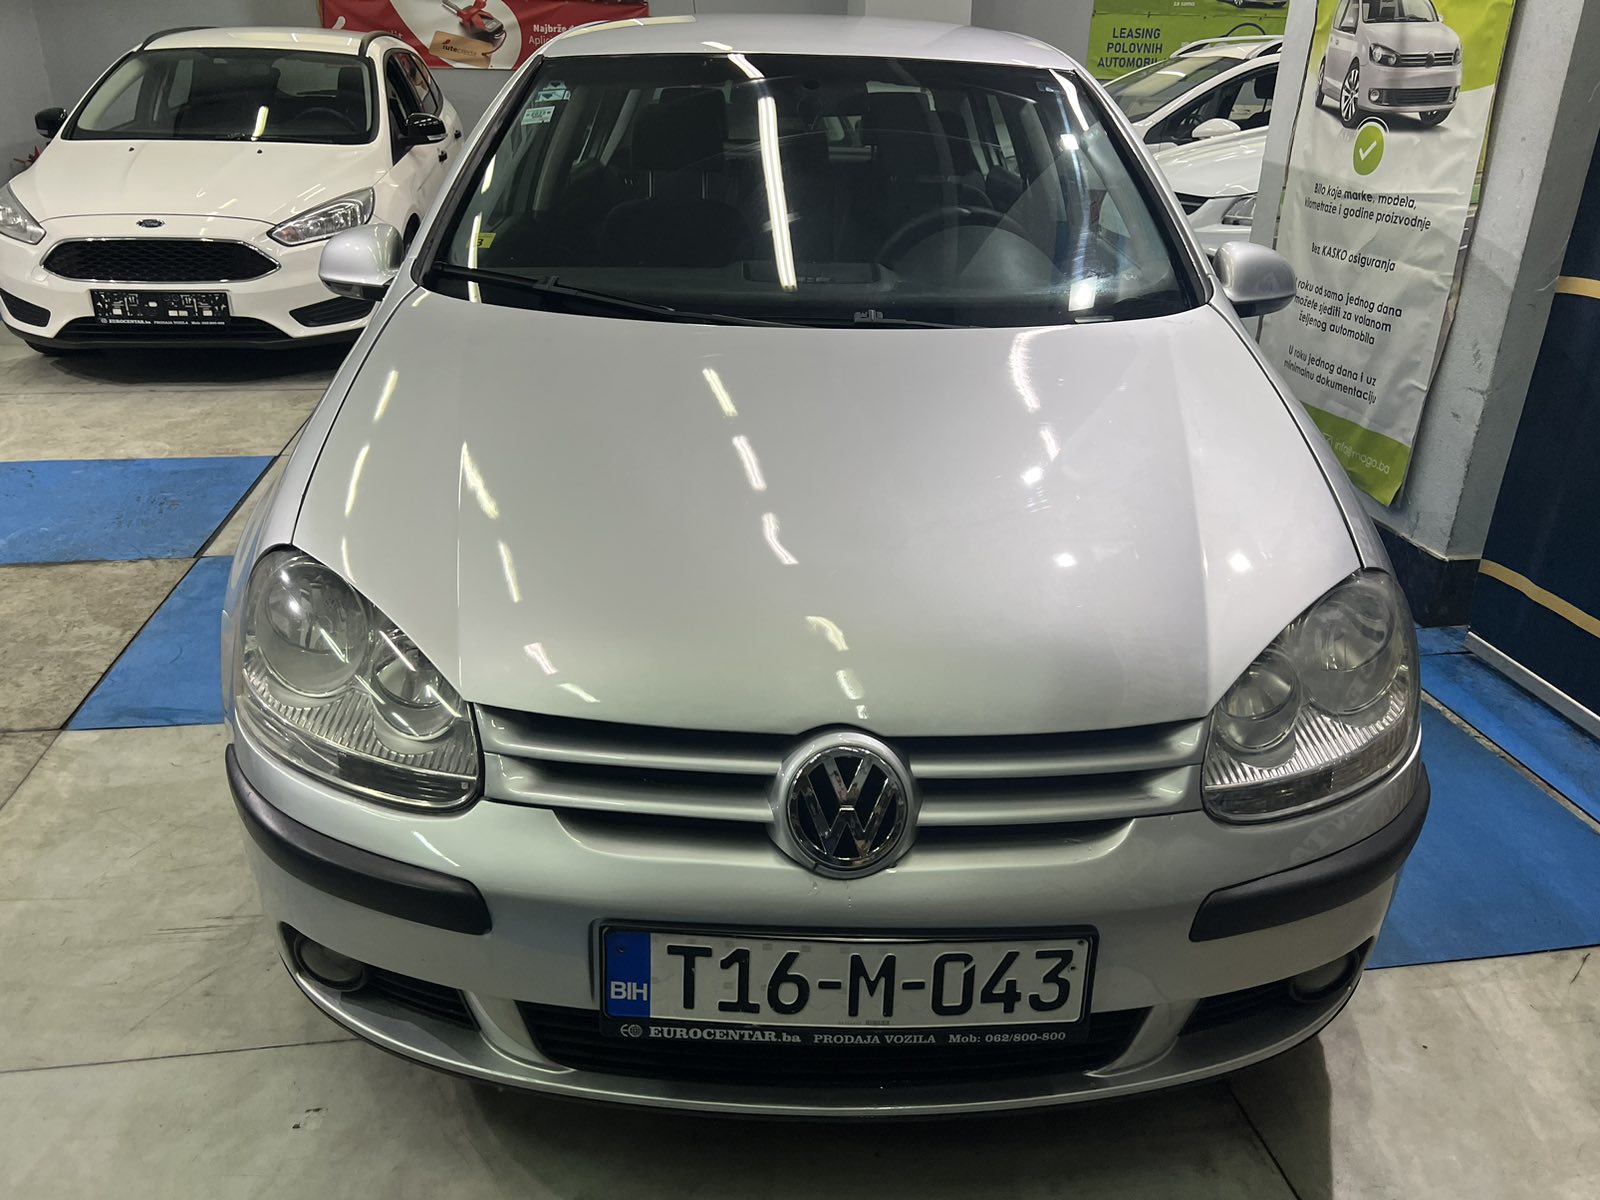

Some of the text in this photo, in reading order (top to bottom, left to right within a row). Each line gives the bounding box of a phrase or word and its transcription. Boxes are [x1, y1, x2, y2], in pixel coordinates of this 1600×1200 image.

[1112, 27, 1161, 39] LEASING
[1106, 42, 1163, 54] POLOVNIH
[1314, 182, 1417, 210] Bilo koje marke, modela,
[1338, 204, 1343, 215] i
[1343, 206, 1375, 219] godine
[1375, 211, 1432, 232] proizvodnje
[1321, 245, 1348, 261] KASKO
[1348, 252, 1396, 273] osiguranja
[1297, 279, 1313, 292] roku
[1314, 284, 1323, 295] od
[1323, 288, 1344, 302] samo
[1345, 292, 1375, 313] jednog
[1376, 302, 1403, 318] dana
[1298, 310, 1375, 345] željenog automobila
[1319, 303, 1341, 318] sjediti
[1342, 310, 1352, 321] za
[1354, 313, 1392, 333] volanom
[1288, 344, 1294, 356] U
[1293, 348, 1307, 362] roku
[1306, 353, 1336, 374] jednog
[1336, 365, 1358, 381] dana
[1365, 376, 1377, 387] uz
[1283, 359, 1377, 405] minimalnu dokumentaciju
[609, 980, 649, 1002] BIH
[666, 944, 1075, 1018] T16-M-043
[649, 1025, 1066, 1045] EUROCENTAR.ba PRODAJA VOZILA Mob: 062/800-800
